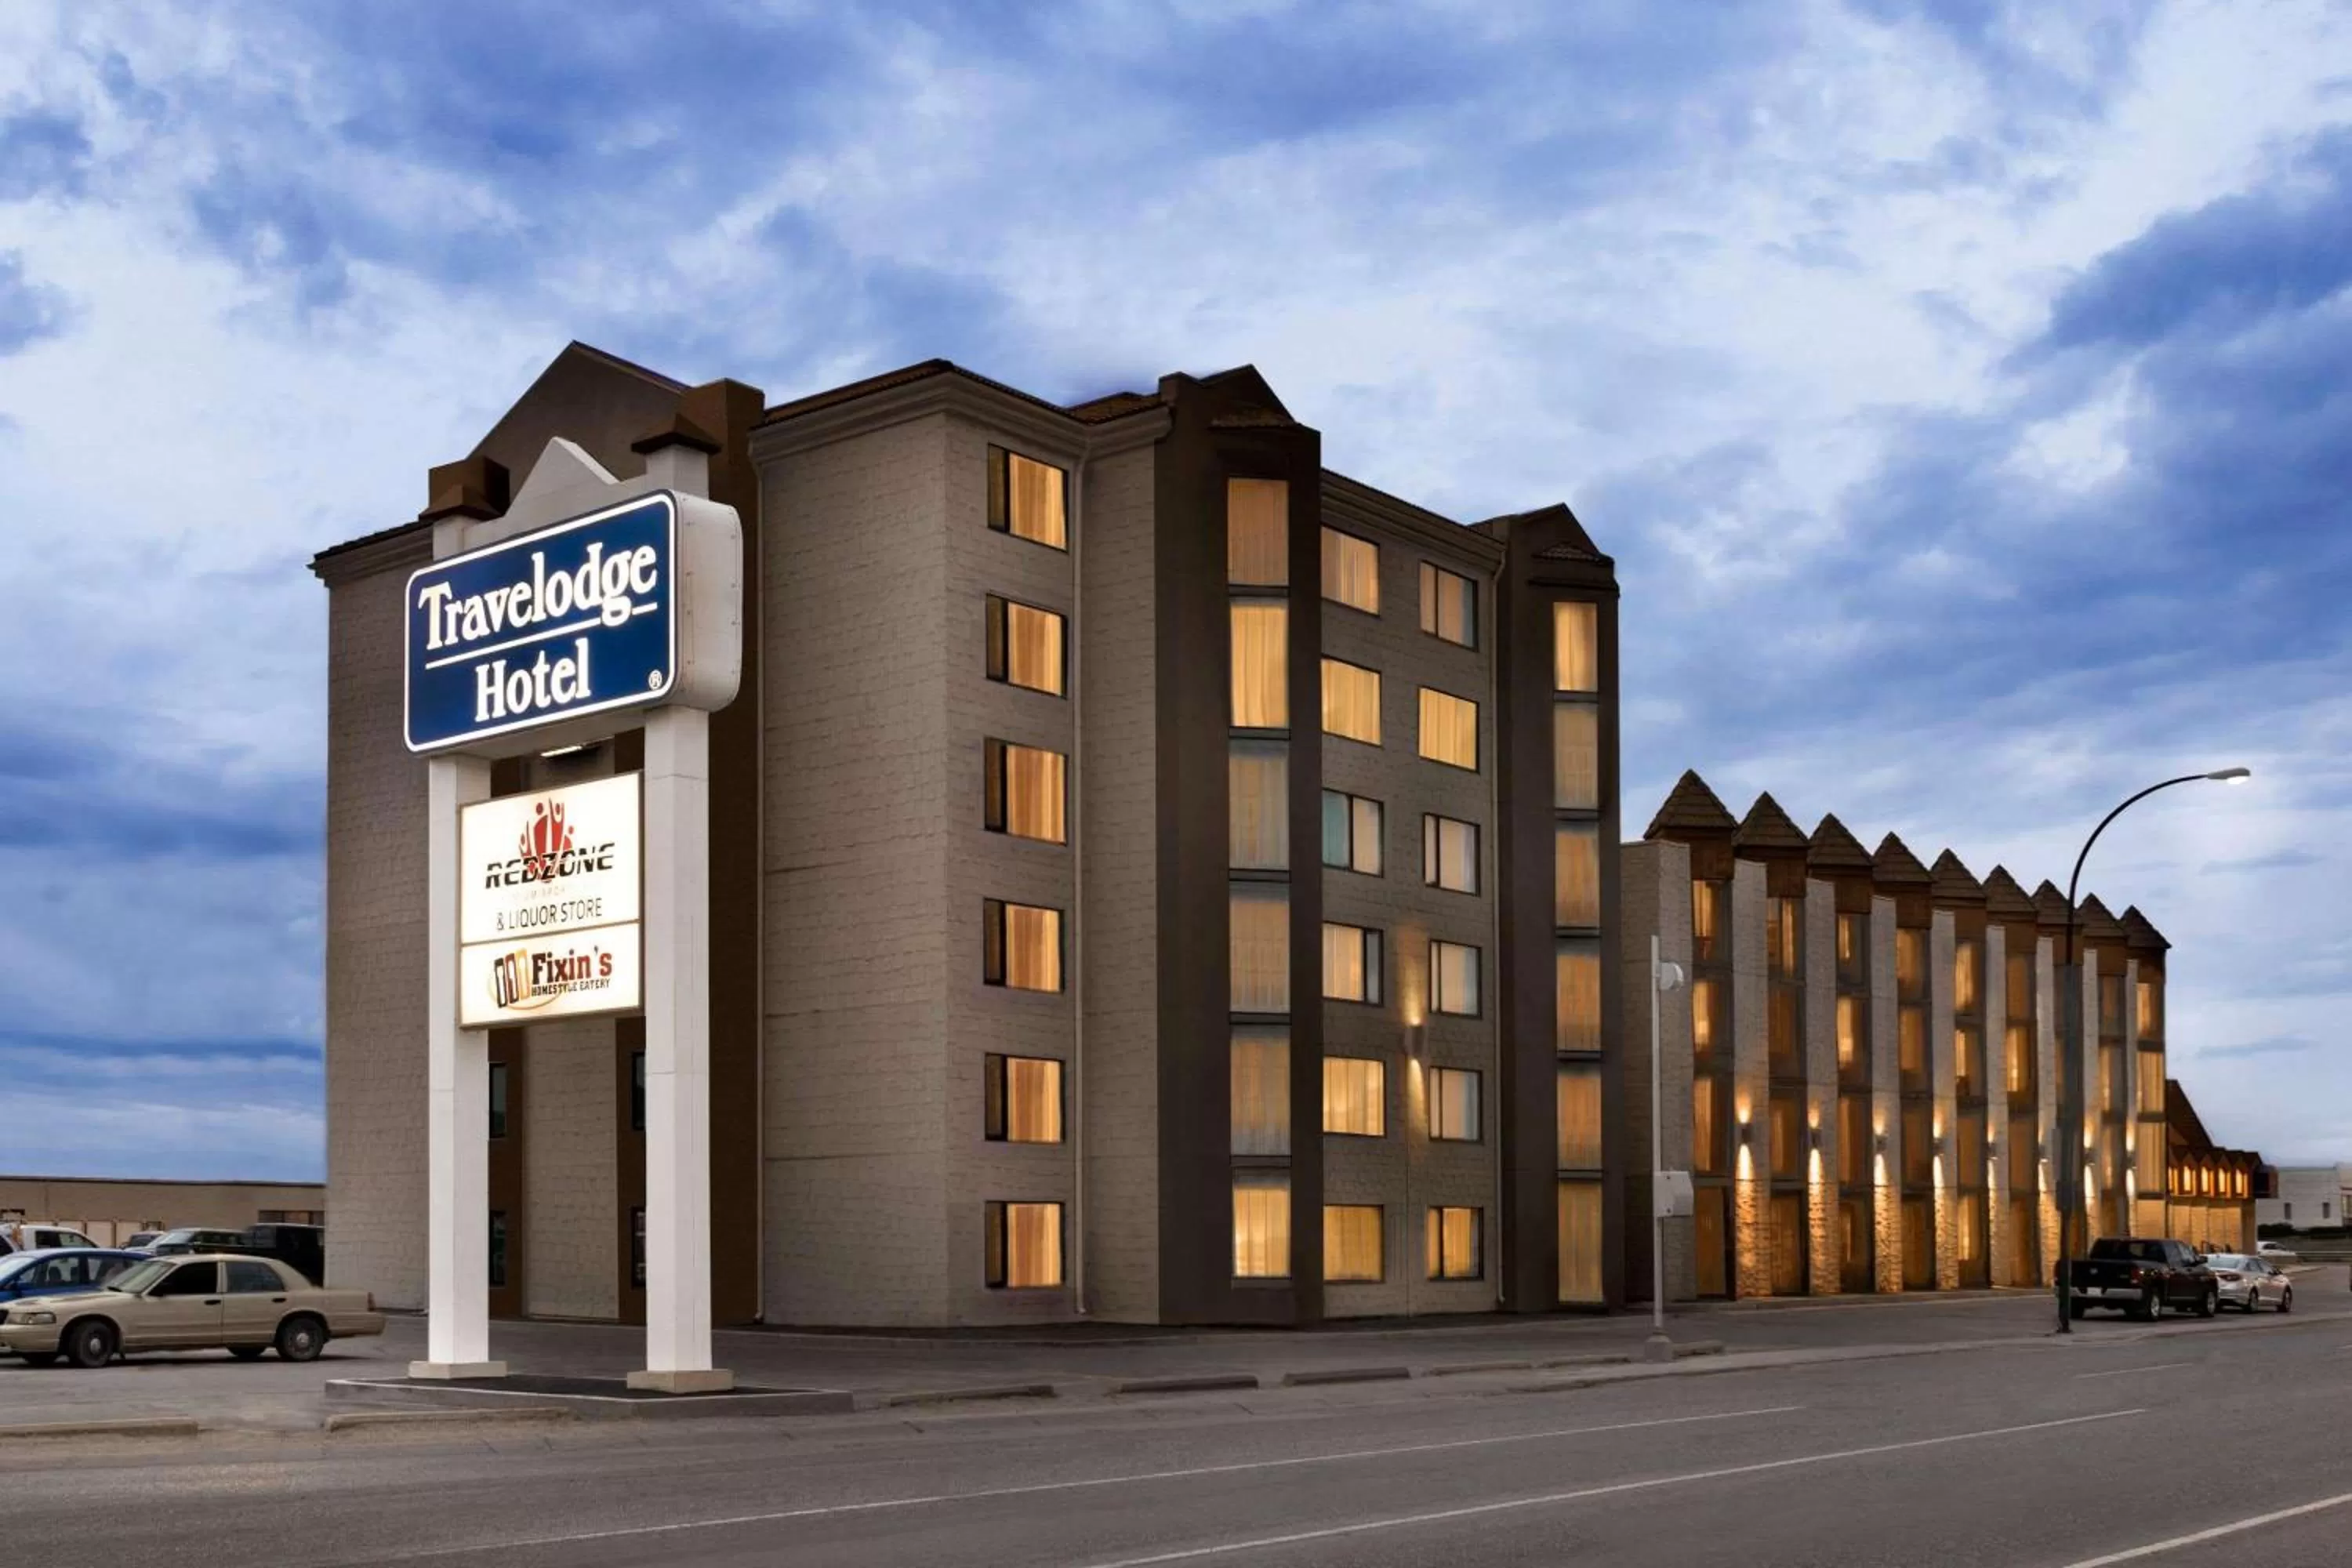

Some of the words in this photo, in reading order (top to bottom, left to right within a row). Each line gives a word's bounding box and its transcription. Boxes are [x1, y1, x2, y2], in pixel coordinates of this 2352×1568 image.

[418, 543, 658, 650] Travelodge
[475, 637, 591, 723] Hotel
[509, 904, 557, 929] LIQUOR
[561, 898, 602, 923] STORE
[532, 946, 612, 985] Fixin's
[579, 978, 611, 992] EATERY
